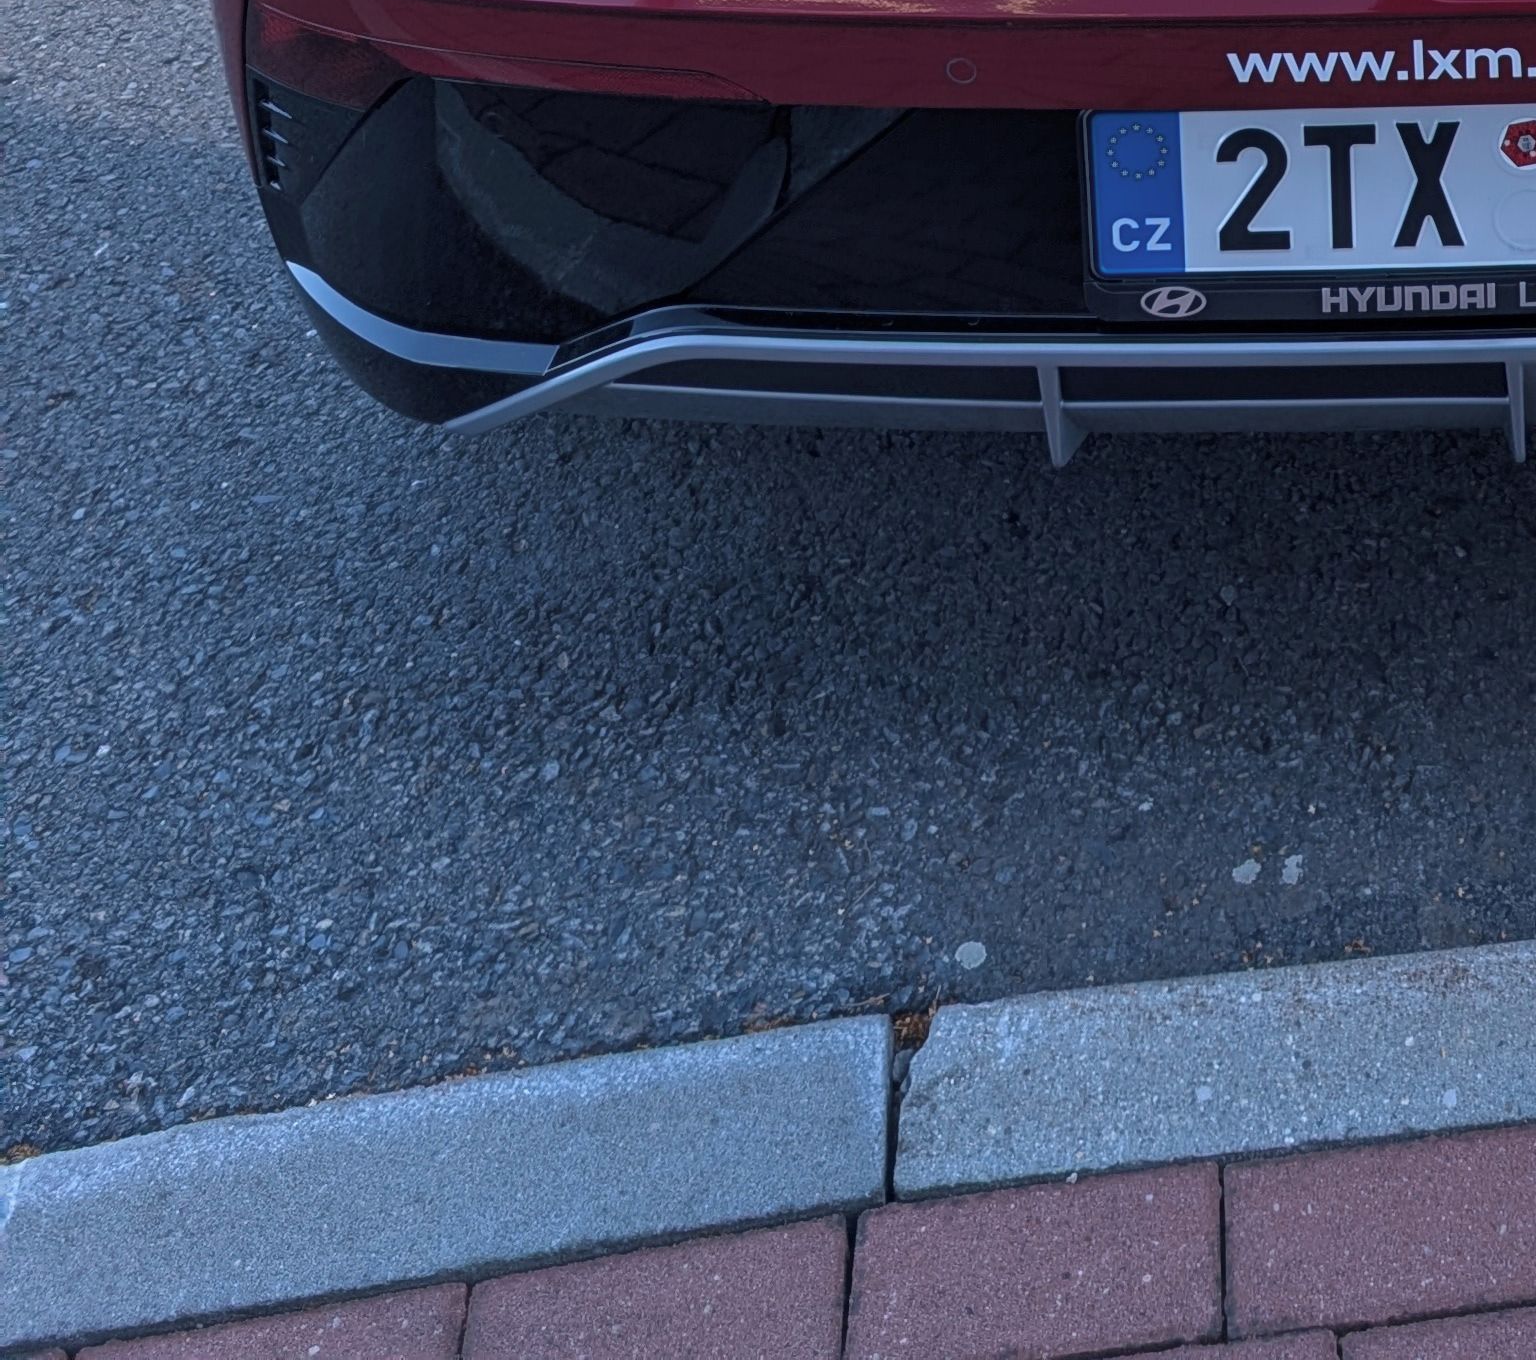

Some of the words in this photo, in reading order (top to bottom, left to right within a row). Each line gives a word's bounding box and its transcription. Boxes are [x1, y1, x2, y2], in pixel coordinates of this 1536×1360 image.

[1215, 121, 1466, 252] 2TX
[1111, 217, 1172, 252] CZ
[1321, 282, 1497, 313] HYUNDAI
